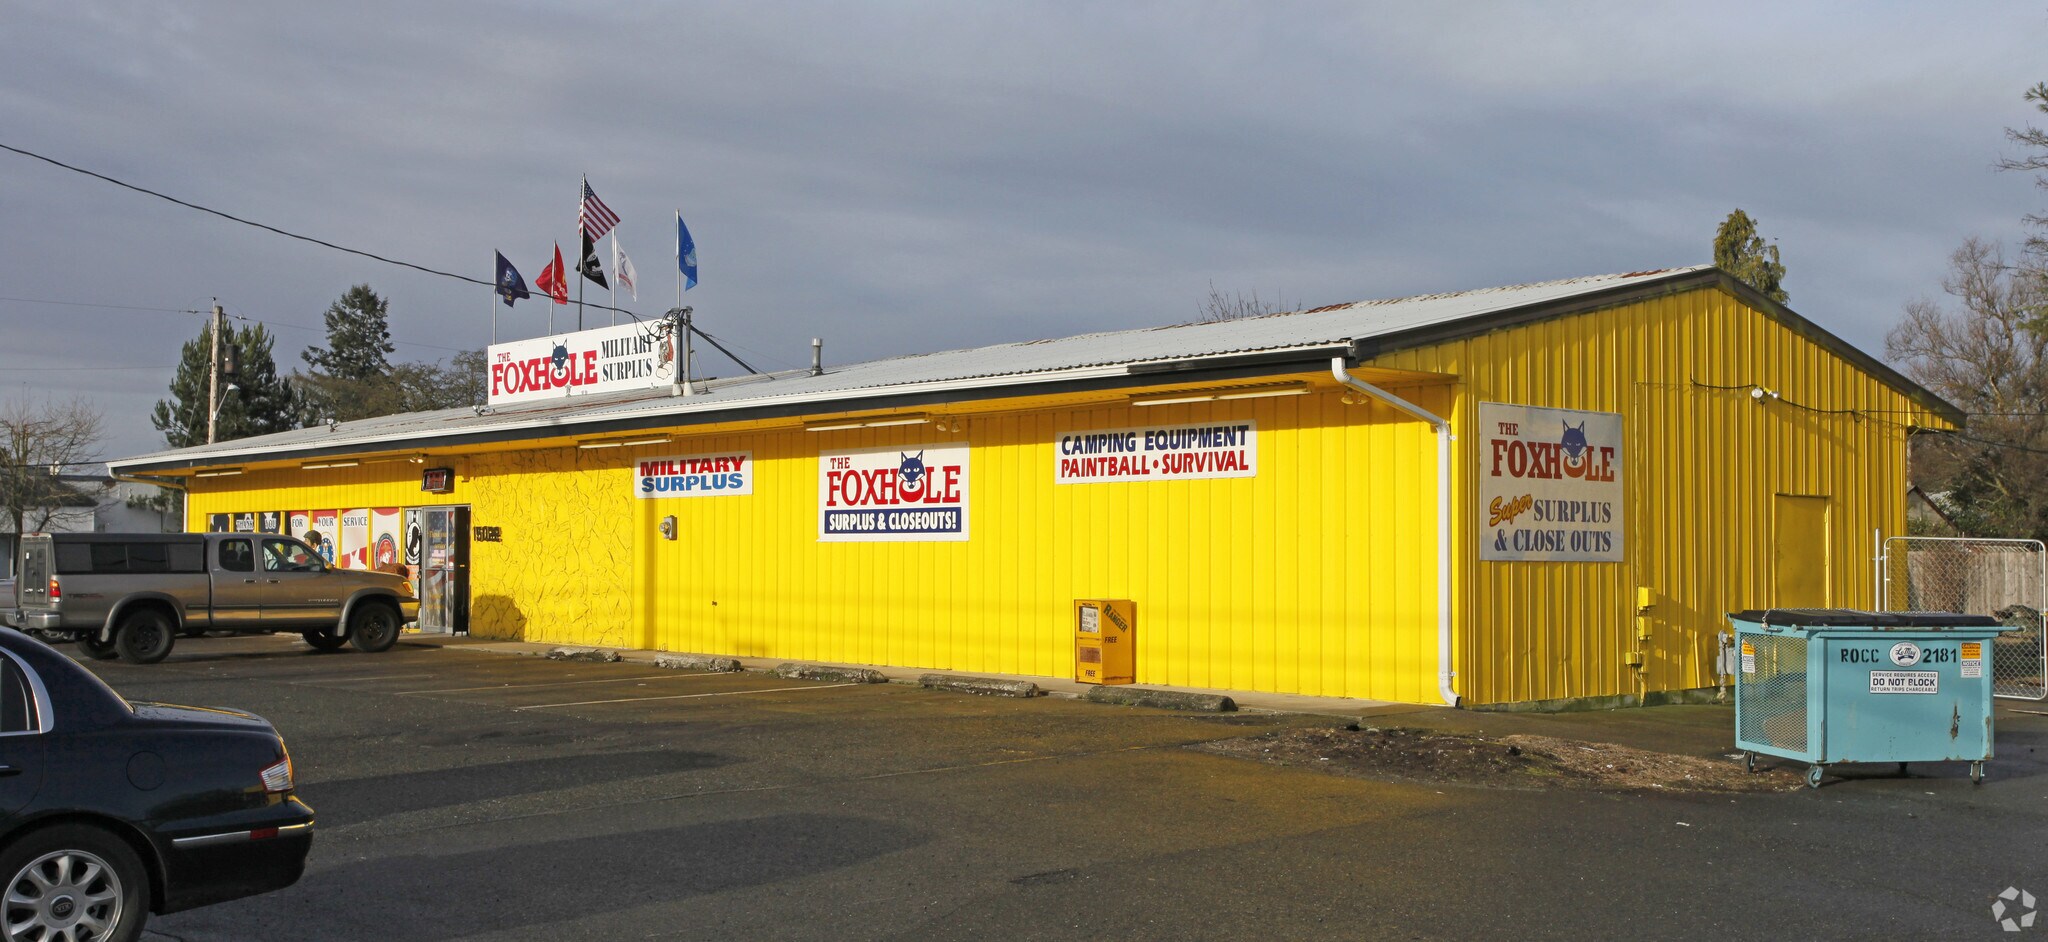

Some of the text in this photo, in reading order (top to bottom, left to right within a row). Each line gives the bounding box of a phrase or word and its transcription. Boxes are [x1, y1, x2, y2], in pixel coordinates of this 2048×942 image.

[497, 352, 511, 363] THE
[601, 335, 652, 359] MILITARY
[492, 350, 598, 396] FOXHOLE
[602, 358, 652, 382] SURPLUS
[1498, 422, 1518, 436] THE
[1061, 425, 1249, 455] CAMPING EQUIPMENT
[640, 455, 746, 476] MILITARY
[830, 457, 850, 469] THE
[1061, 450, 1249, 478] PAINTBALL SURVIVAL
[1491, 439, 1615, 482] FOXHOLE
[642, 473, 744, 492] SURPLUS
[826, 465, 961, 506] FOXHOLE
[1489, 493, 1611, 527] Super SURPLUS
[292, 519, 303, 527] FOR
[318, 518, 334, 527] YOUR
[343, 517, 368, 527] SERVICE
[829, 511, 957, 531] SURPLUS & CLOSEOUTS!
[1494, 528, 1611, 552] & CLOSE OUTS
[1104, 603, 1128, 633] RANGER
[1841, 648, 1879, 663] ROCC
[1923, 648, 1957, 663] 2181
[1085, 669, 1096, 677] FREE
[1872, 678, 1935, 686] DO NOT BLOCK
